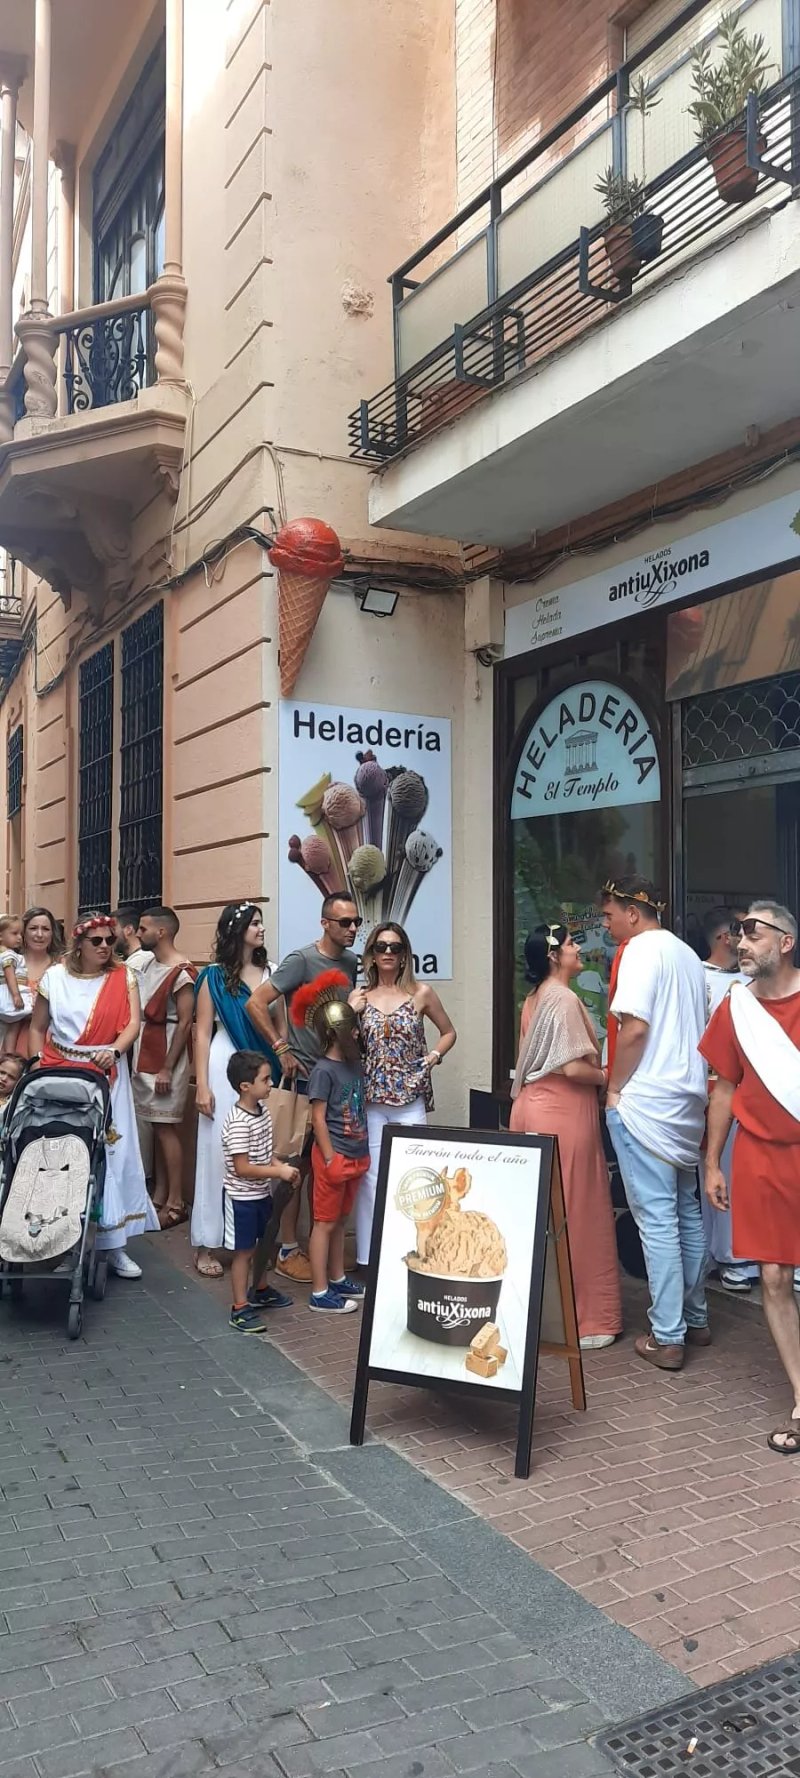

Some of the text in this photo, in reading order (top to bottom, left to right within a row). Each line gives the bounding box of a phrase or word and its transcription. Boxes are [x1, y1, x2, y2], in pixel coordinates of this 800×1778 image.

[643, 547, 672, 564] HELADOS
[608, 549, 710, 608] antiuXixona
[293, 709, 441, 752] Heladería
[516, 692, 656, 799] HELADERÍA
[543, 771, 619, 801] El Templo
[454, 1149, 484, 1161] todo
[487, 1151, 502, 1162] el
[502, 1154, 528, 1165] año
[399, 1182, 445, 1206] PREMIUM
[417, 1298, 491, 1326] antiuXixona
[443, 1294, 468, 1303] HELADOS
